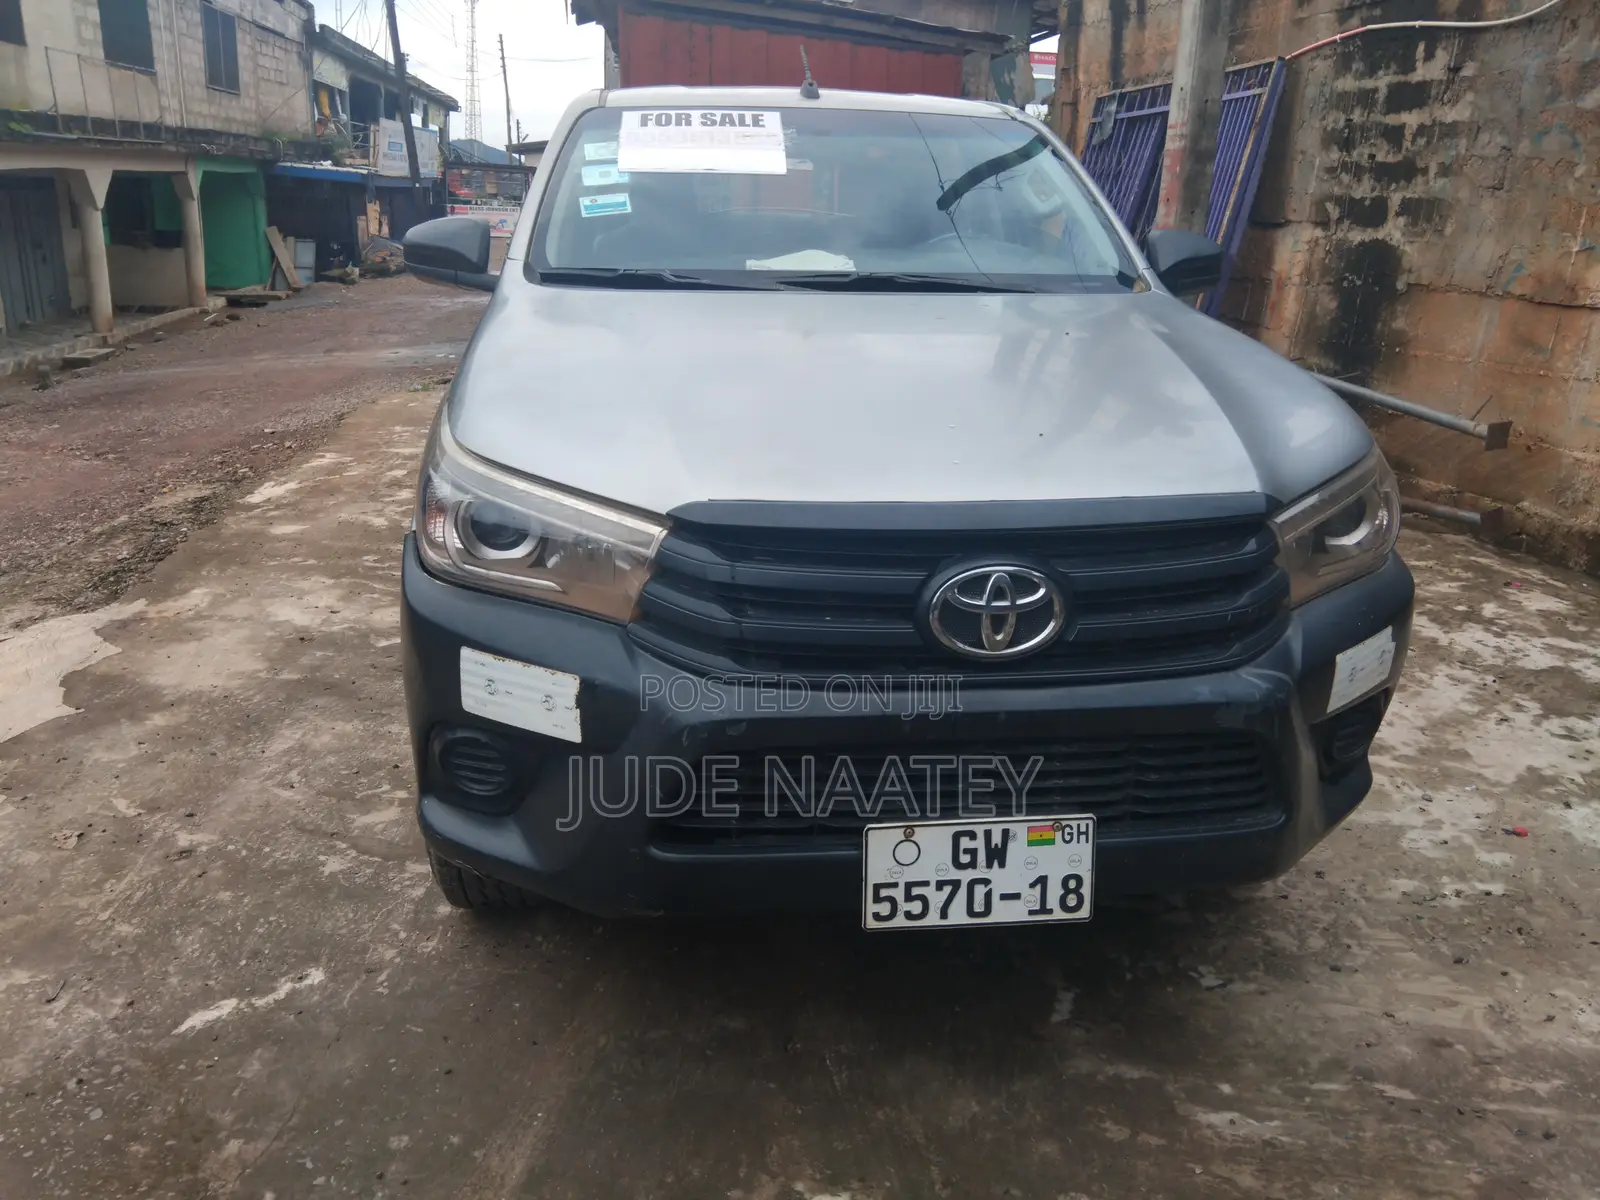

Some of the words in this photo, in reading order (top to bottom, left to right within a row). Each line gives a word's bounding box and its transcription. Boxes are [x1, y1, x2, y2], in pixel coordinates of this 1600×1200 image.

[639, 112, 692, 128] FOR
[700, 112, 766, 128] SALE
[951, 828, 1010, 870] GW
[1061, 823, 1090, 844] GH
[871, 873, 1085, 922] 5570-18
